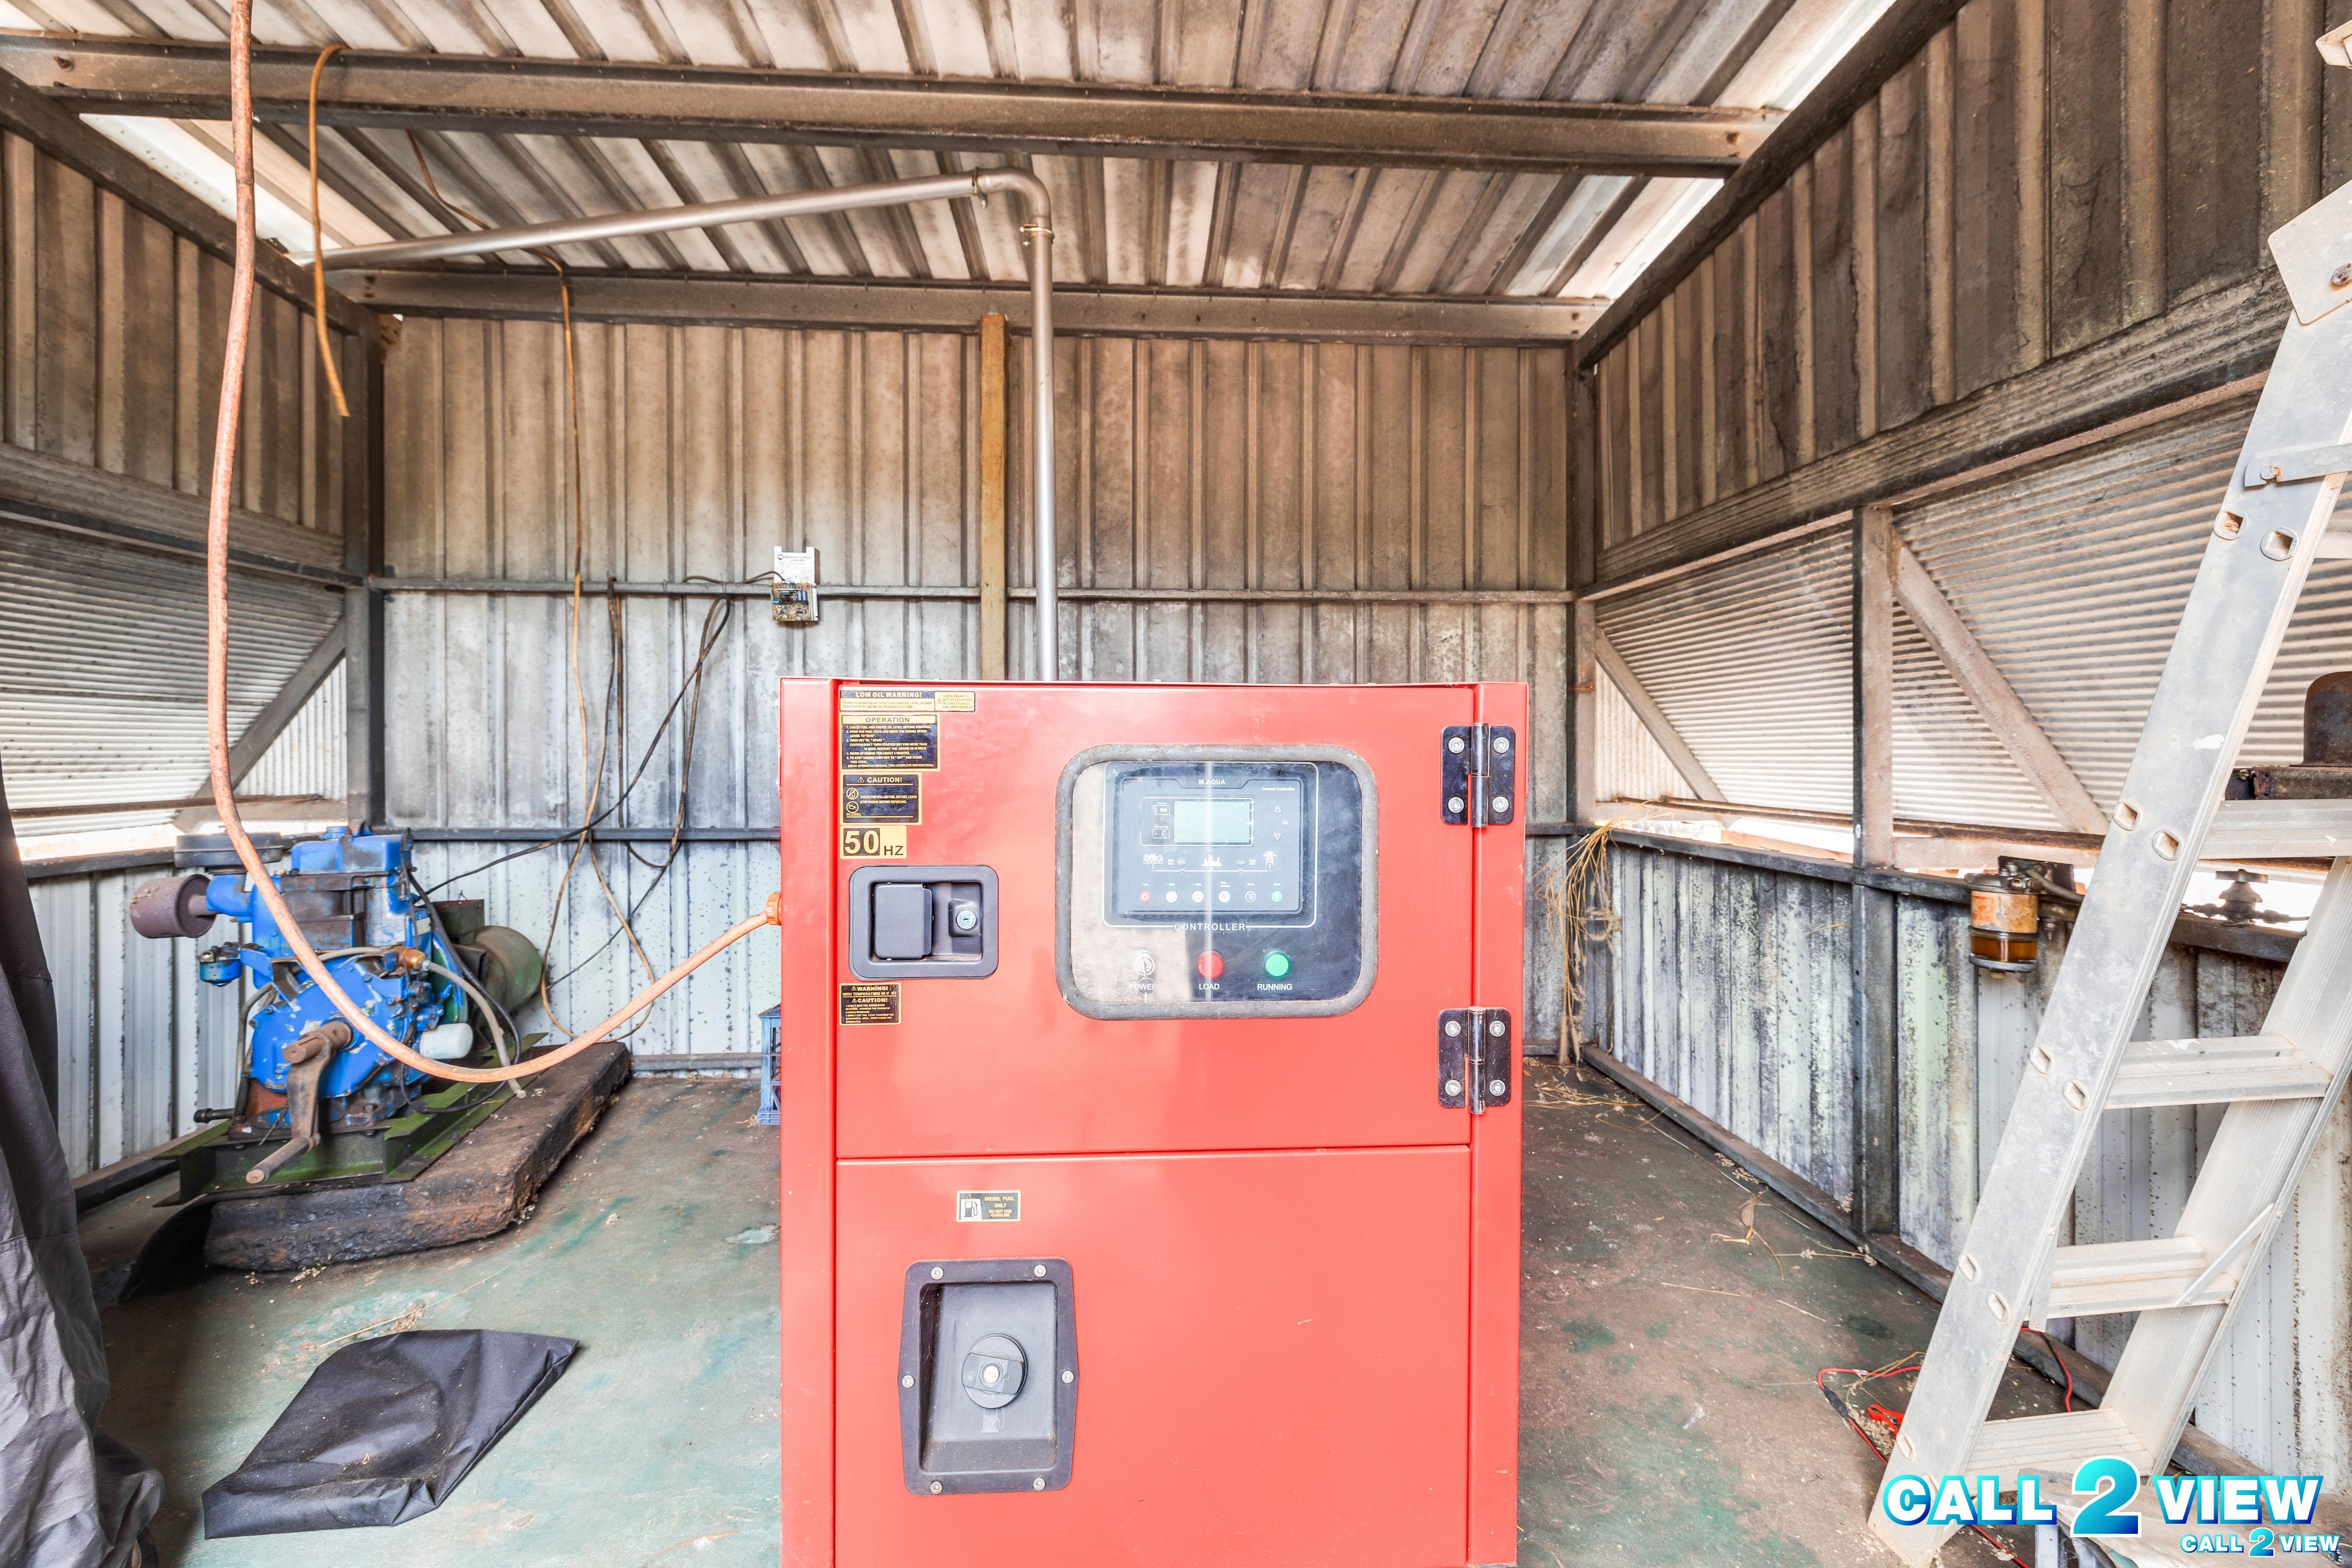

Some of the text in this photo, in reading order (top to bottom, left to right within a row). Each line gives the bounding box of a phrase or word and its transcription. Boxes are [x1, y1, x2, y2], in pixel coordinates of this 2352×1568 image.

[844, 830, 903, 855] 50 HZ
[1174, 923, 1246, 931] CONTROLLER
